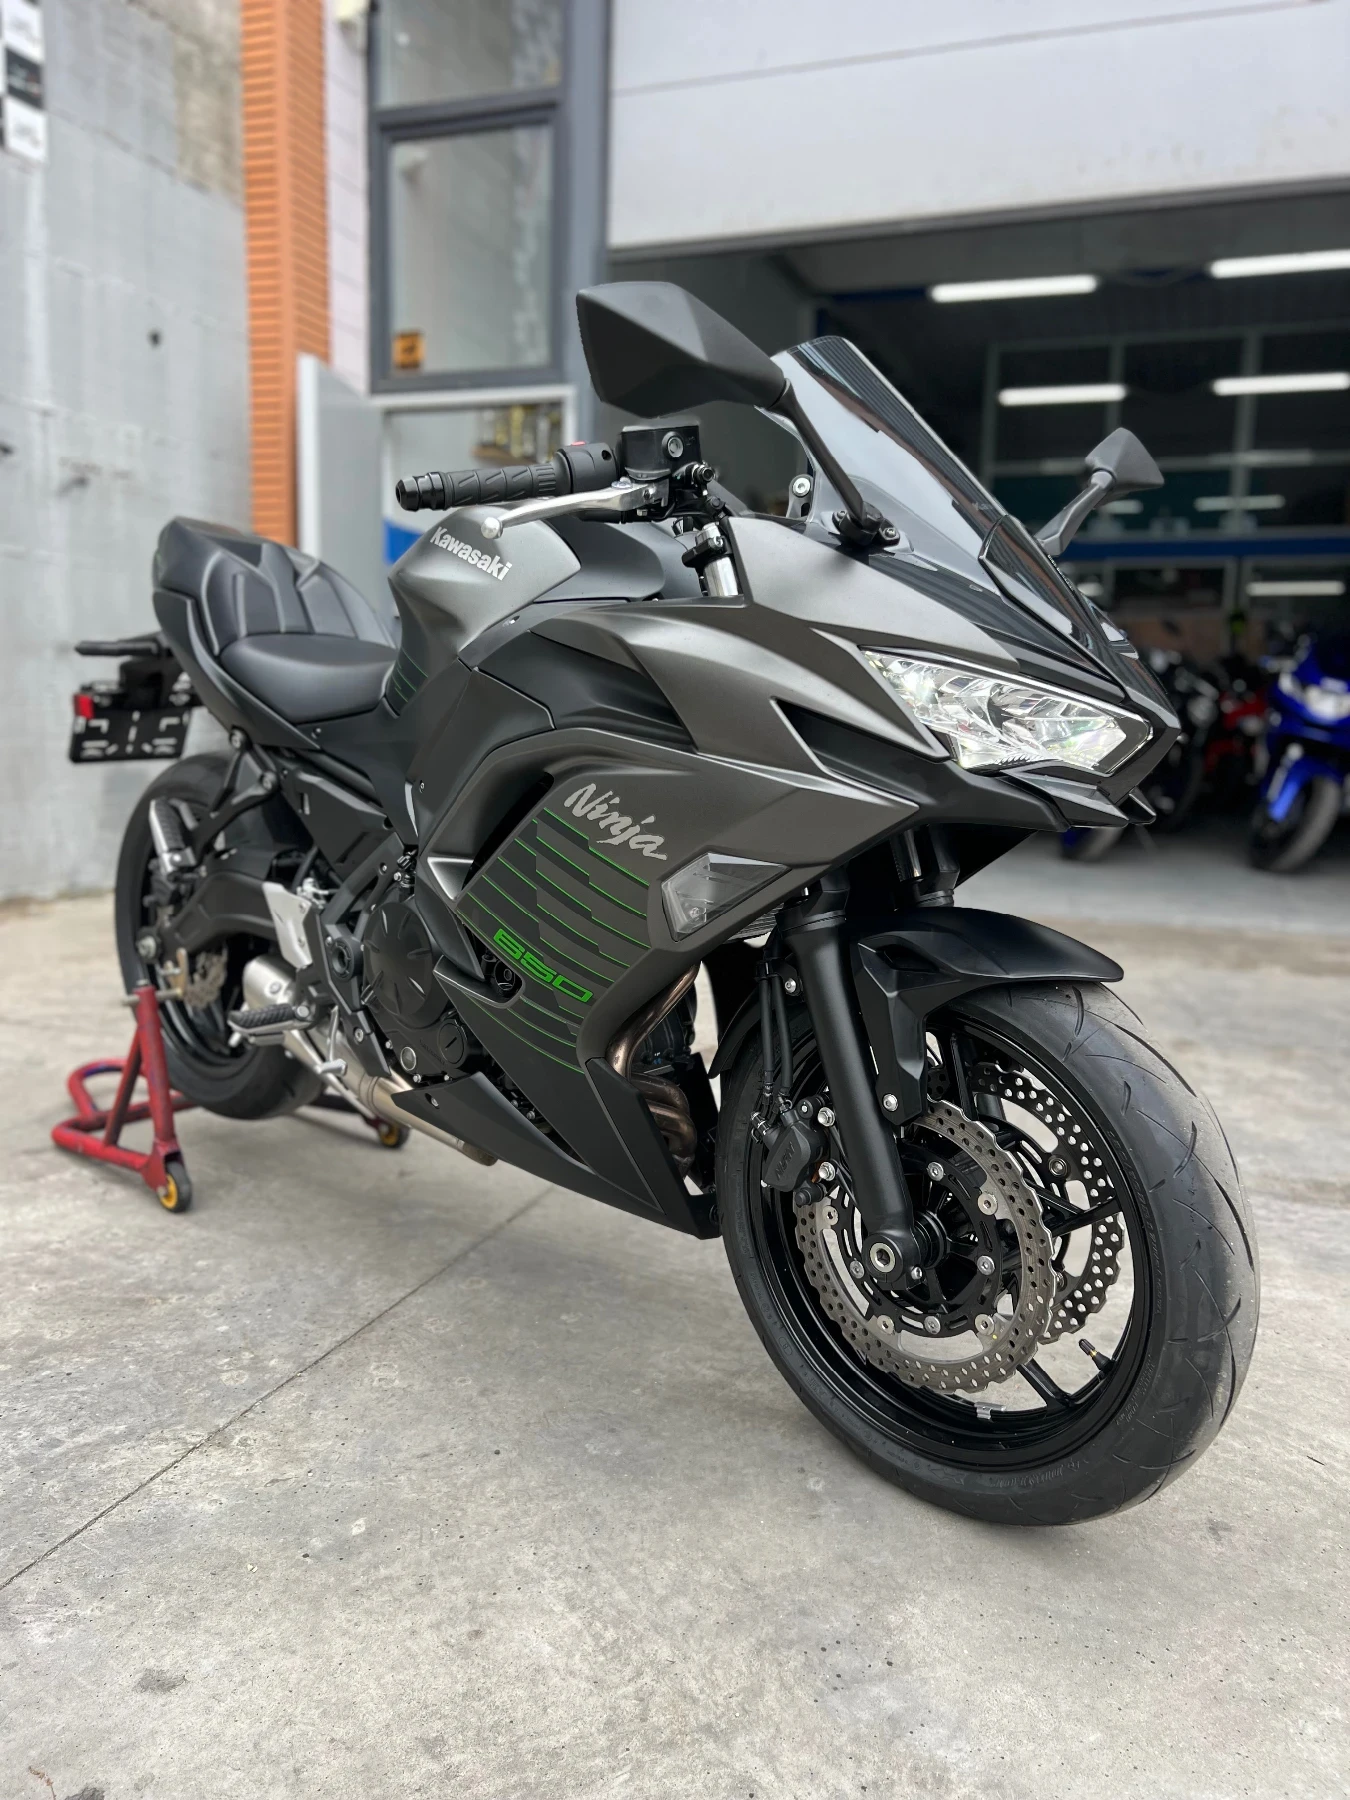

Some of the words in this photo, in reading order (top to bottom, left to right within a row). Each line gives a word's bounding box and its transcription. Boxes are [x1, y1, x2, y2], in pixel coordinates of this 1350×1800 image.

[430, 526, 512, 581] Kawasaki
[563, 783, 668, 861] Ninja
[493, 928, 594, 1003] 650
